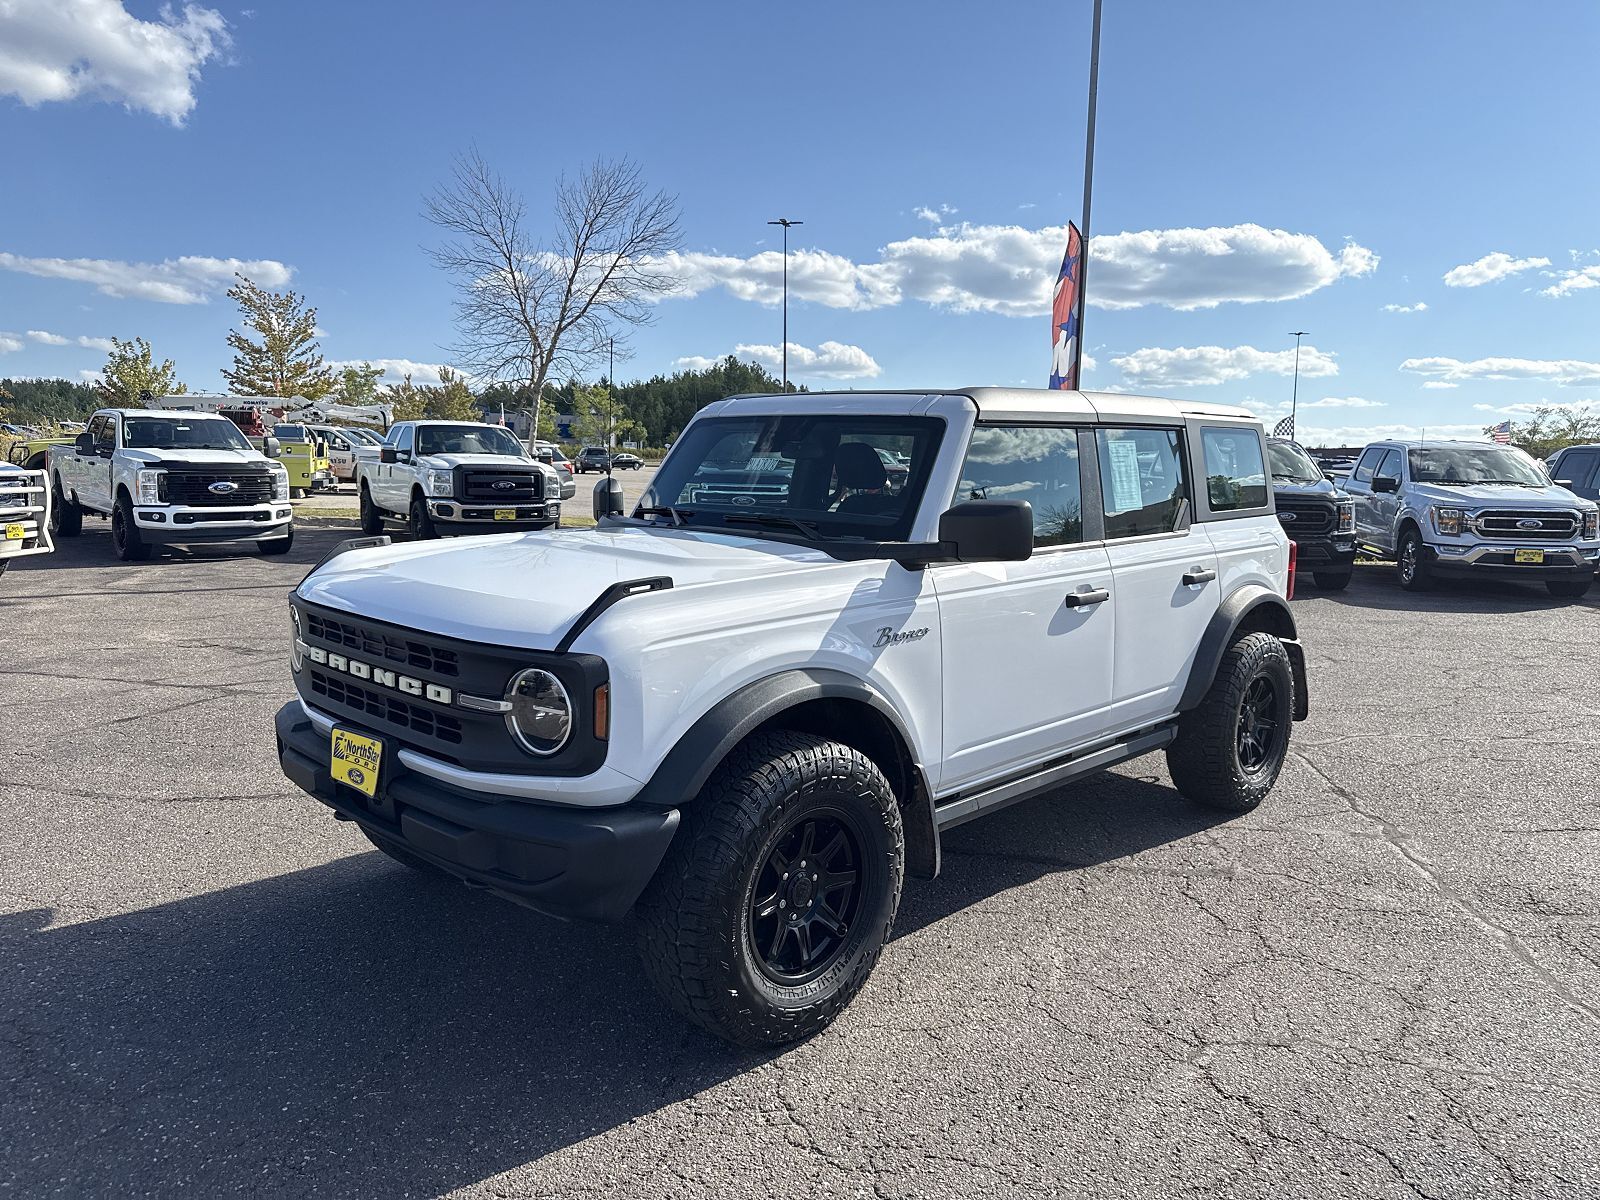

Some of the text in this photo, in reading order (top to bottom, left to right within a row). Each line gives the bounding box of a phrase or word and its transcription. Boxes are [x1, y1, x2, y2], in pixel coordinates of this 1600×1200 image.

[872, 626, 931, 648] Bronco
[309, 646, 452, 704] BRONCO
[346, 738, 379, 763] NorthStar
